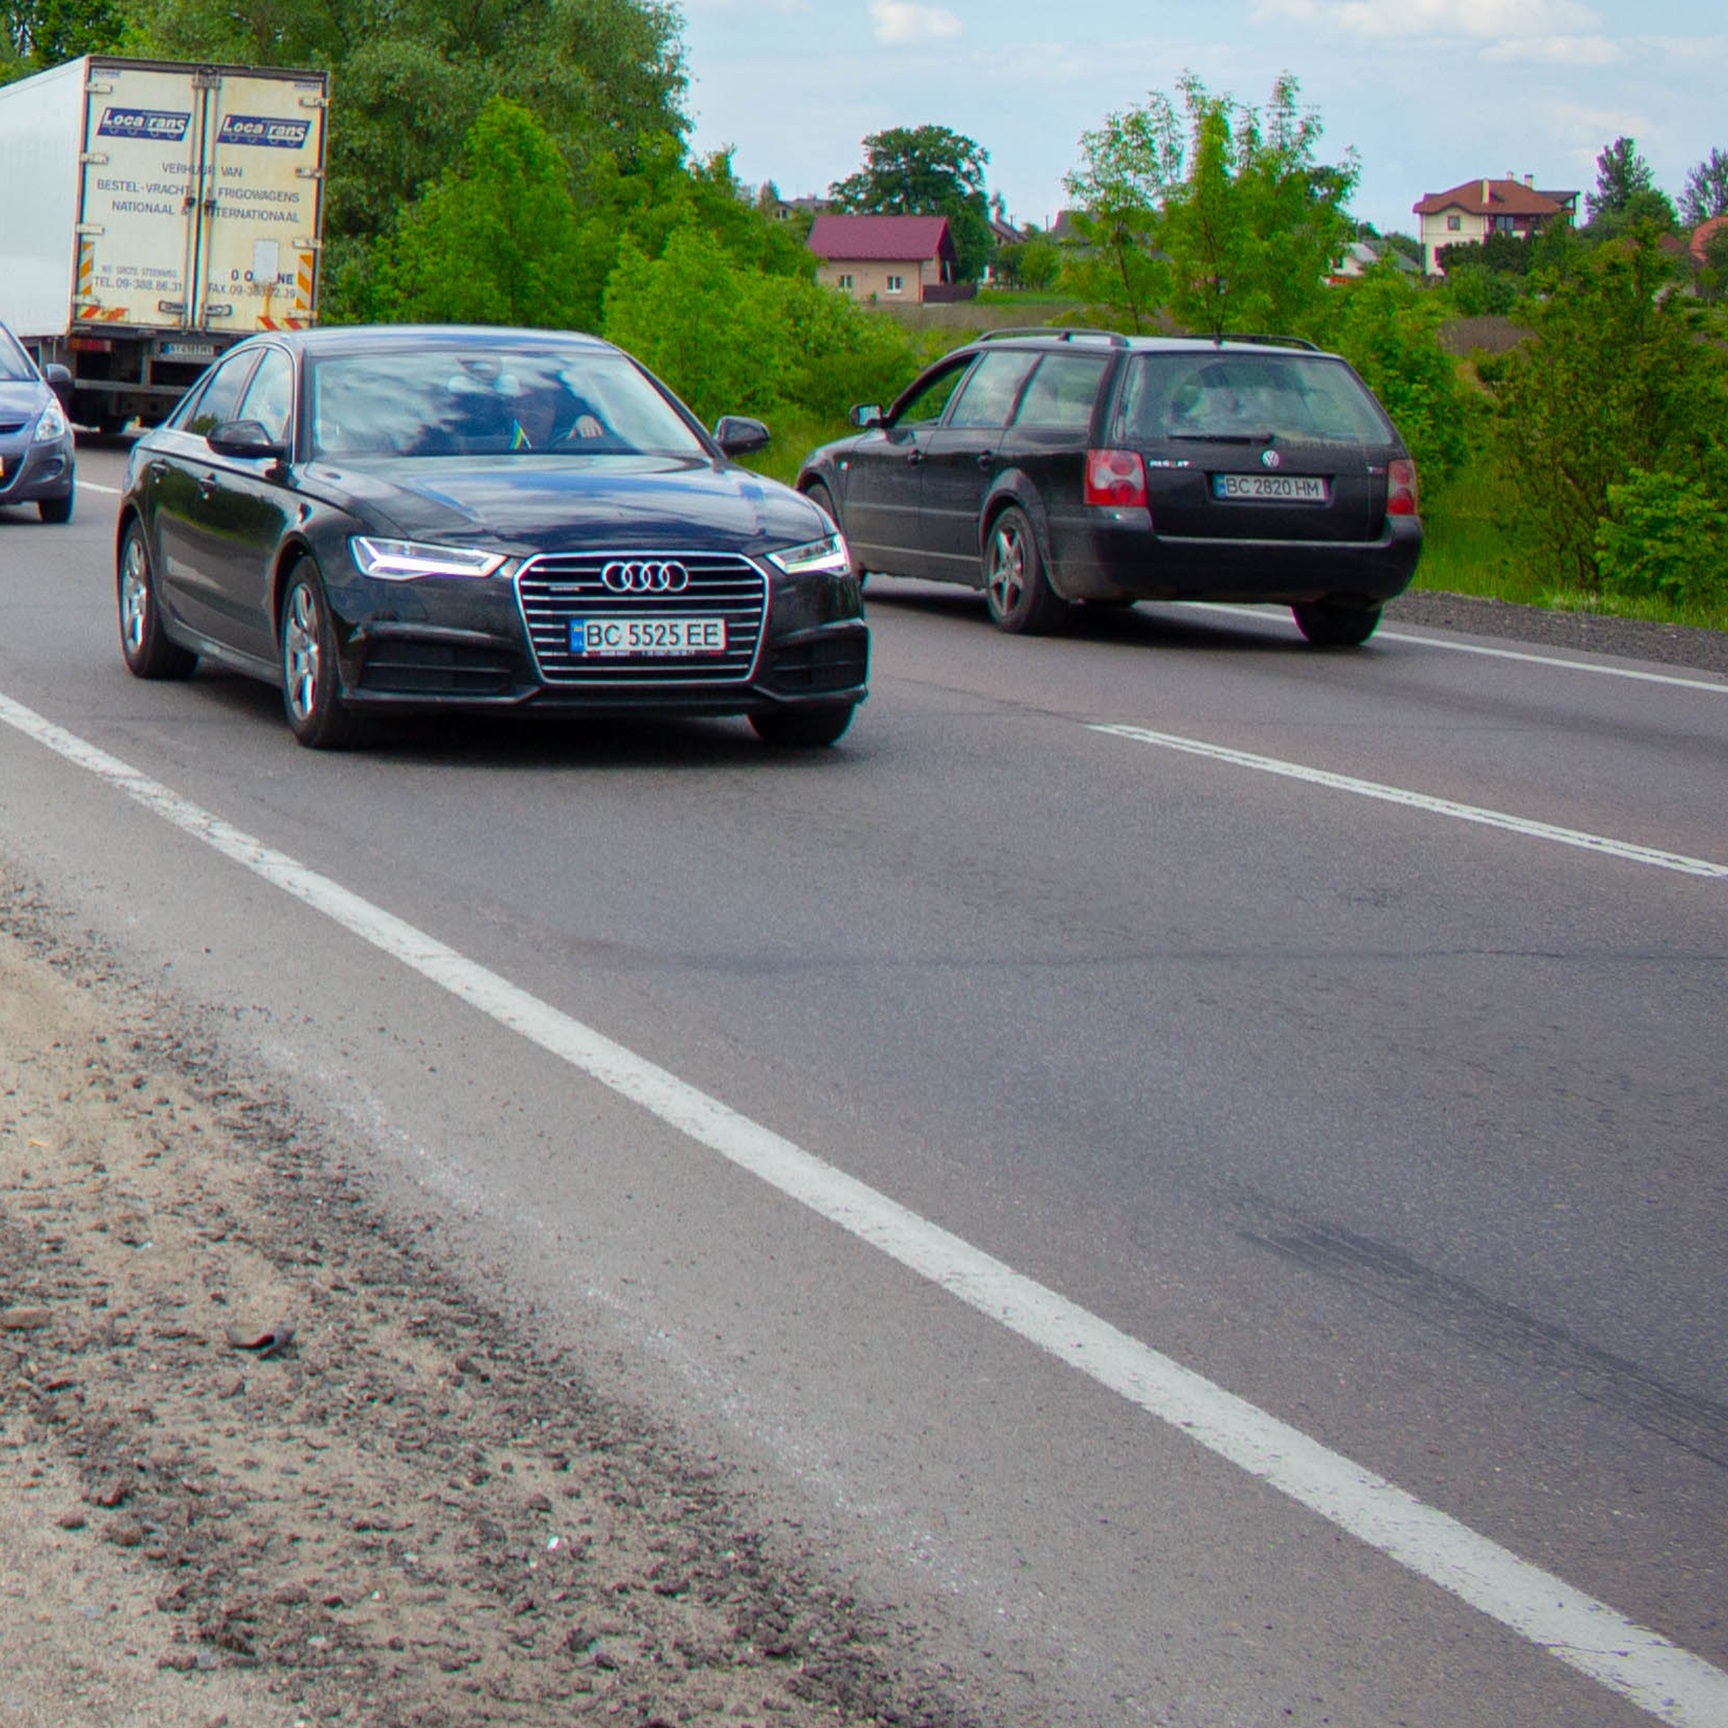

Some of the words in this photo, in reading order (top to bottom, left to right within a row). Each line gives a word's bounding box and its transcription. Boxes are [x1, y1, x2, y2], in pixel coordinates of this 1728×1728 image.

[220, 166, 243, 177] VAN
[111, 200, 175, 215] NATIONAAL
[1226, 477, 1251, 494] BC
[1255, 479, 1292, 495] 2820
[1295, 480, 1320, 496] HM
[586, 624, 621, 647] BC
[628, 623, 681, 646] 5525
[686, 623, 720, 646] EE
